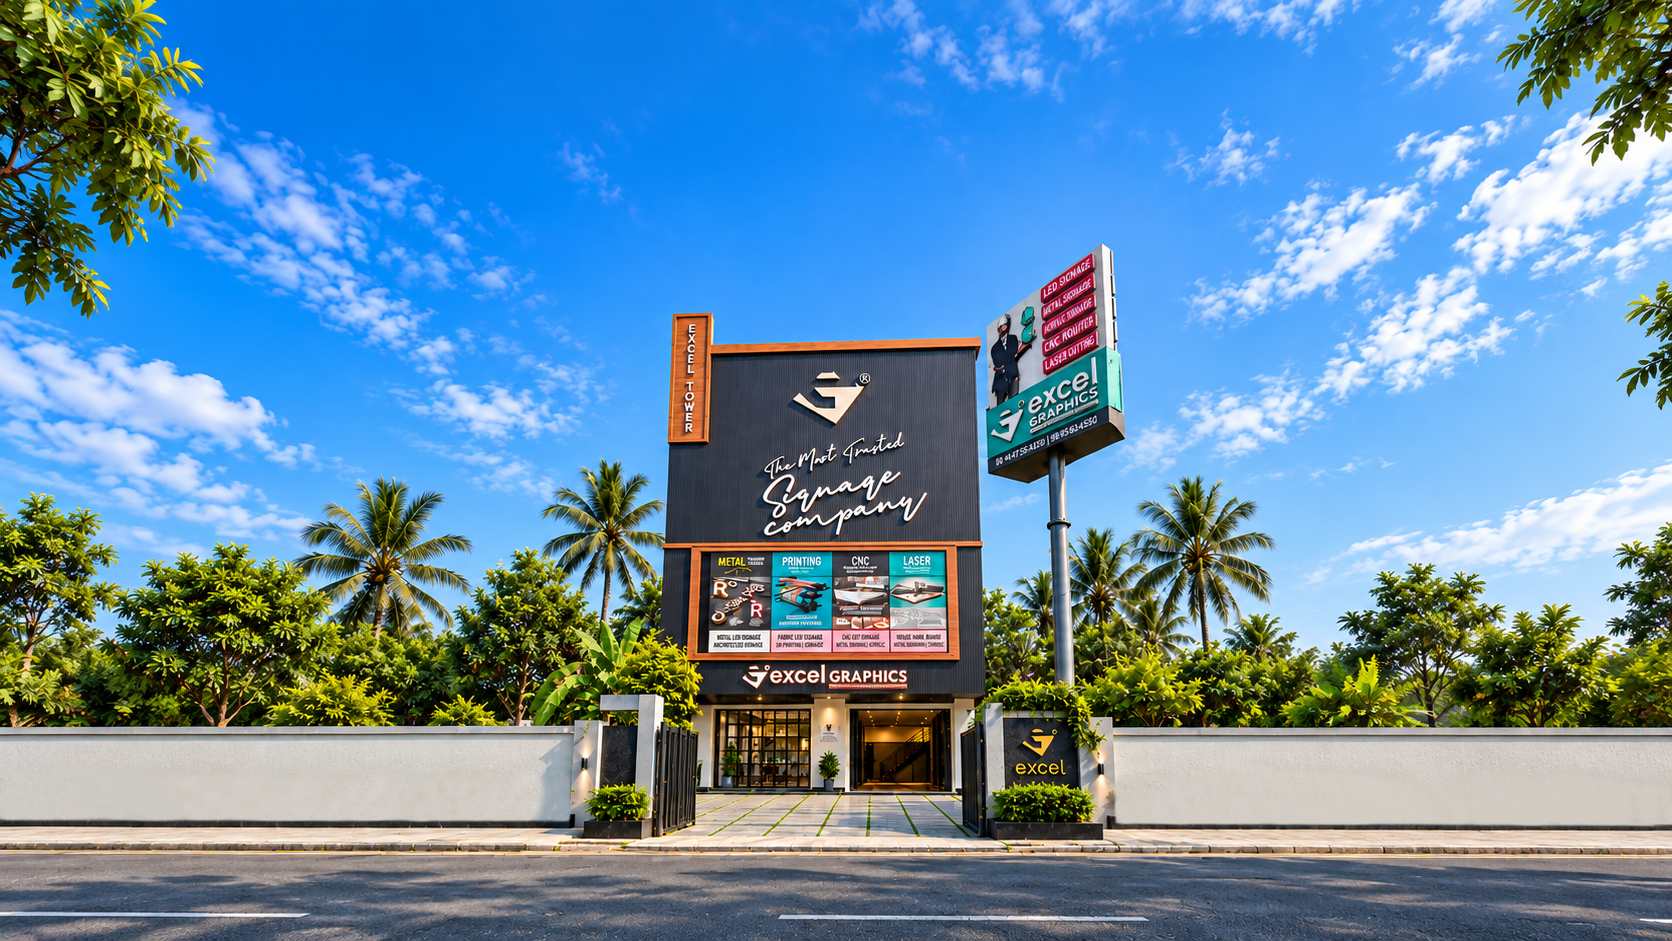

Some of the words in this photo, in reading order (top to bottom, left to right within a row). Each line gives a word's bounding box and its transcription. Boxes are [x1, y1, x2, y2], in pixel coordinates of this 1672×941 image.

[1043, 282, 1058, 299] LED
[687, 323, 696, 374] EXCEL
[1028, 356, 1097, 414] excel
[684, 381, 695, 433] TOWER
[1029, 386, 1098, 427] GRAPHICS
[764, 455, 796, 479] The
[798, 443, 837, 471] Most
[843, 431, 904, 464] Trusted
[762, 469, 901, 519] Signage
[763, 492, 928, 536] company
[718, 556, 746, 567] METAL
[782, 556, 822, 567] PRINTING
[851, 555, 870, 566] CNC
[903, 555, 931, 566] LASER
[769, 664, 825, 684] excel
[828, 669, 908, 683] GRAPHICS
[1015, 759, 1067, 775] excel
